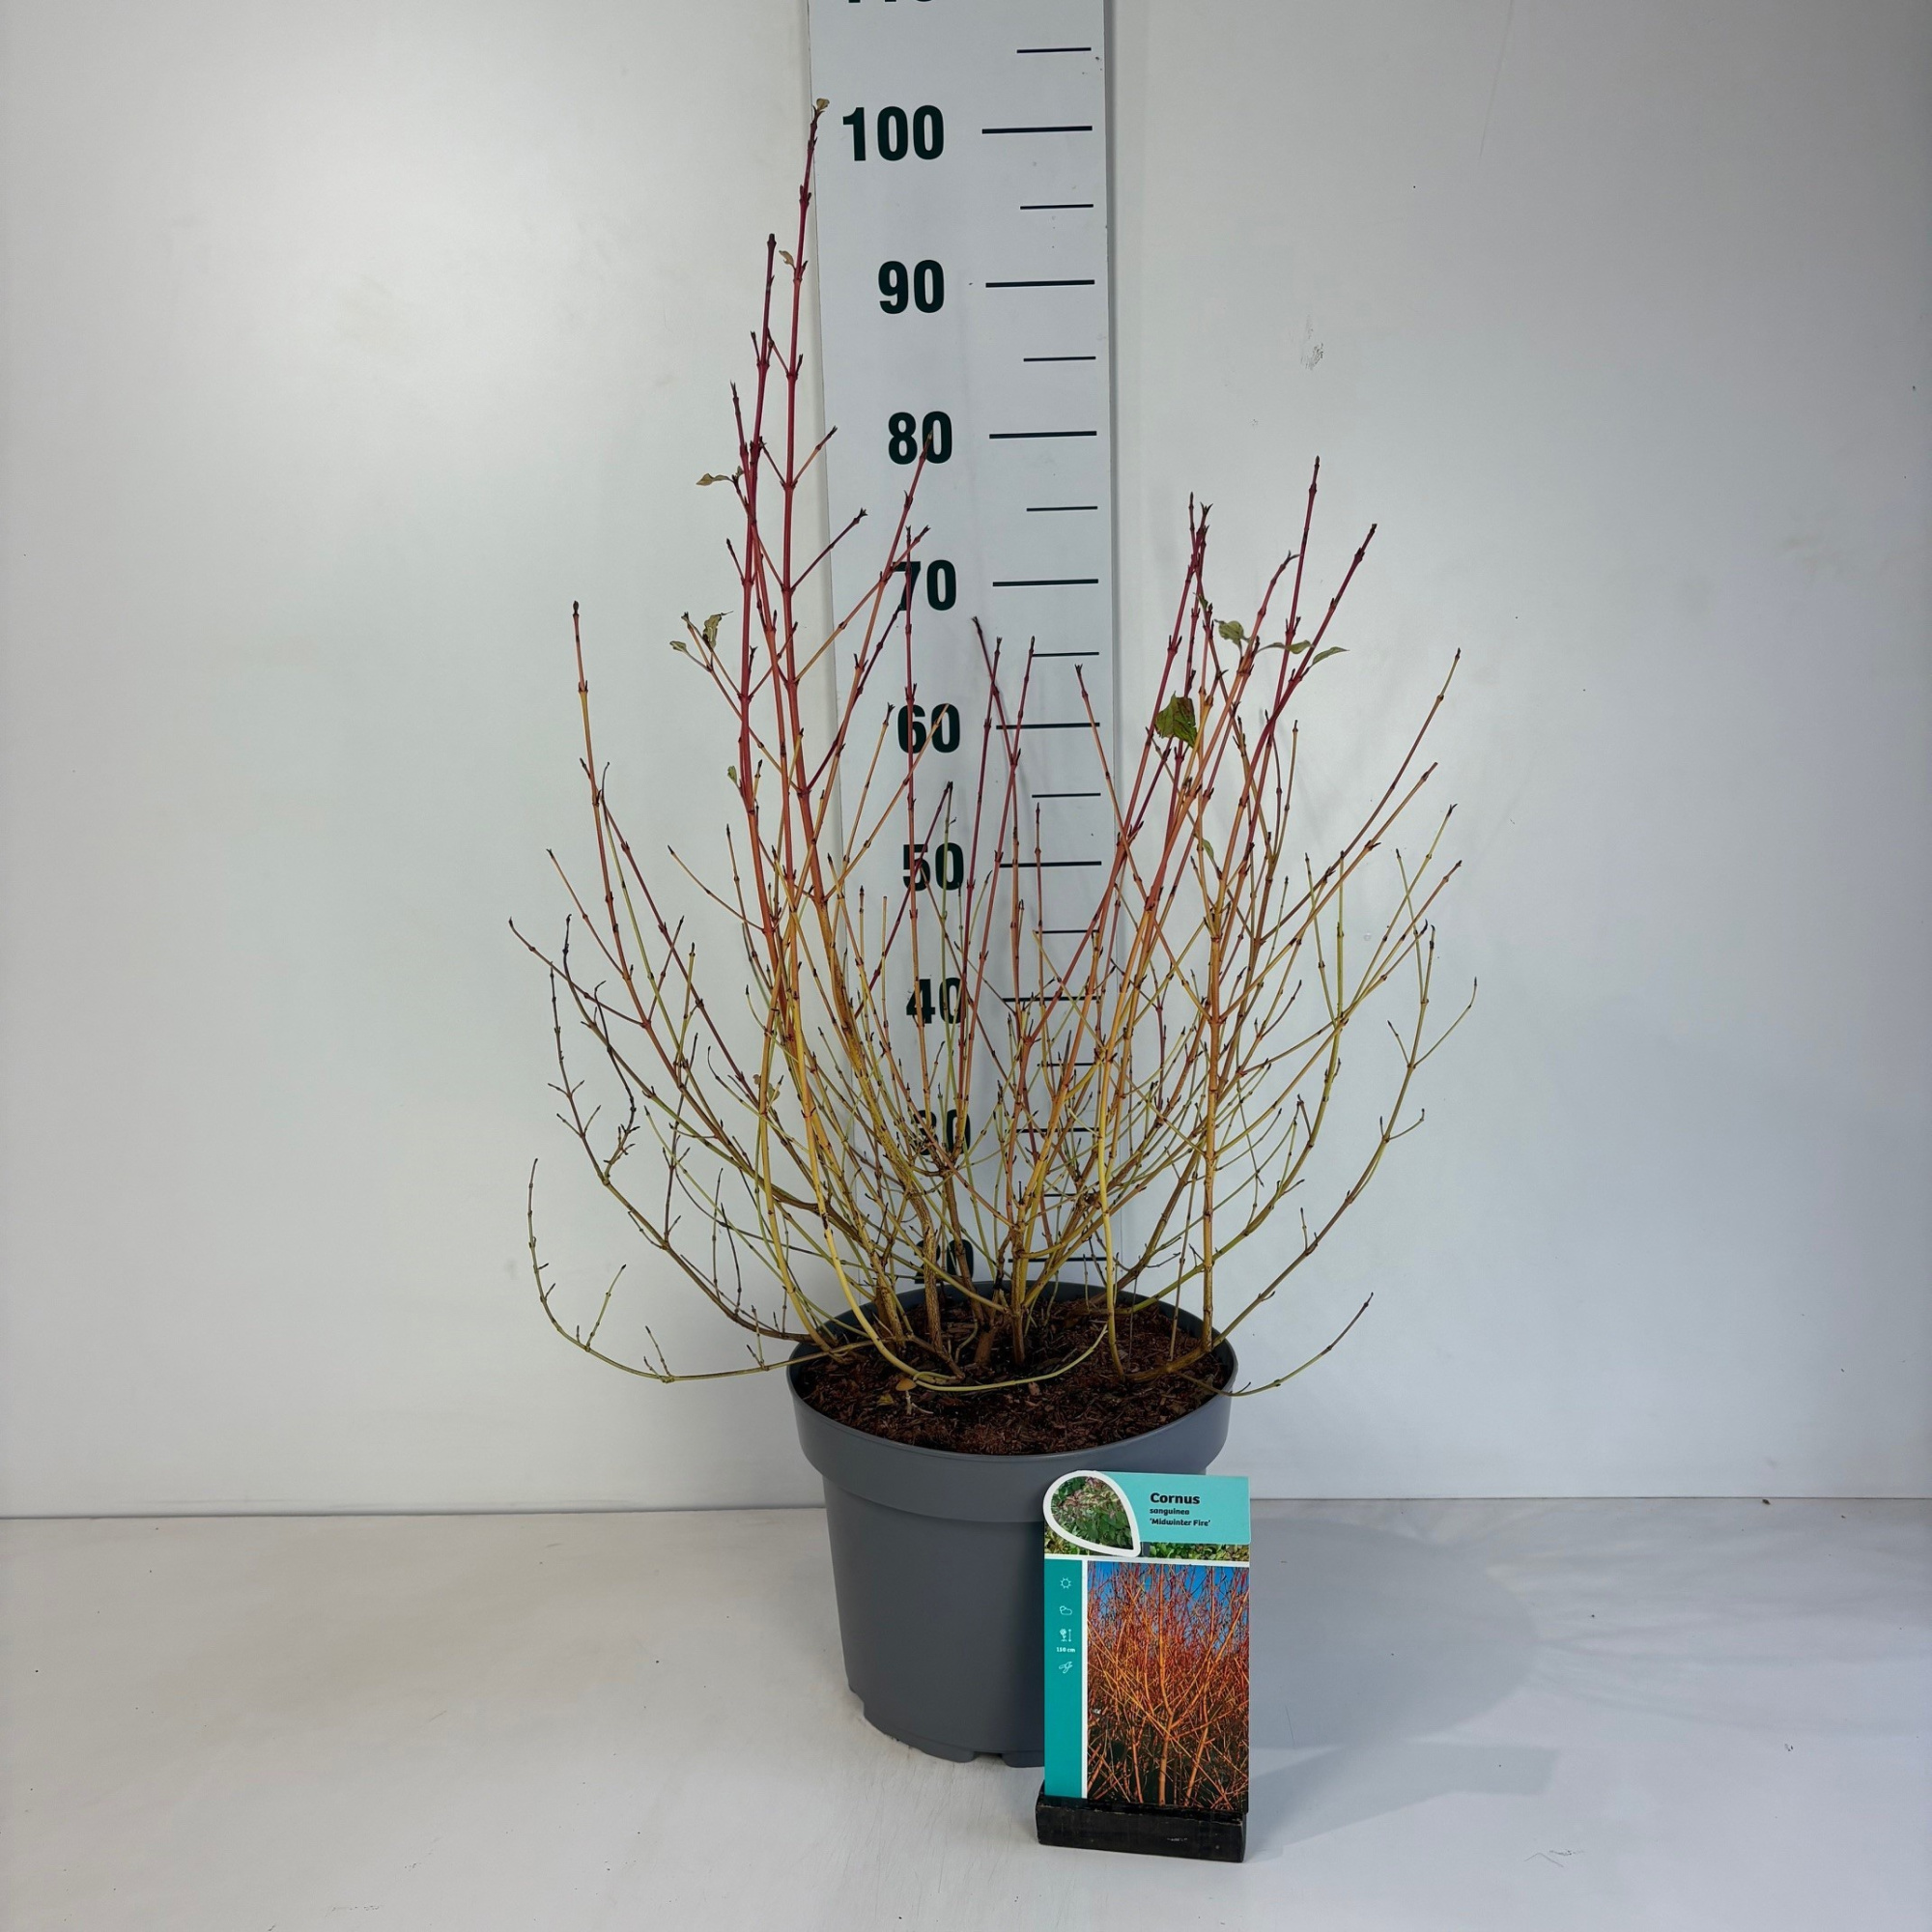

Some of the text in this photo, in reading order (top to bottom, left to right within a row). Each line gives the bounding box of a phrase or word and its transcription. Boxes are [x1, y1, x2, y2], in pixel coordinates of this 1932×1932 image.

[842, 104, 945, 161] 100
[878, 259, 945, 314] 90
[888, 411, 952, 466] 80
[891, 559, 956, 611] 70
[897, 703, 960, 753] 60
[902, 842, 964, 892] 50
[906, 977, 965, 1024] 40
[1150, 1492, 1201, 1505] Cornus
